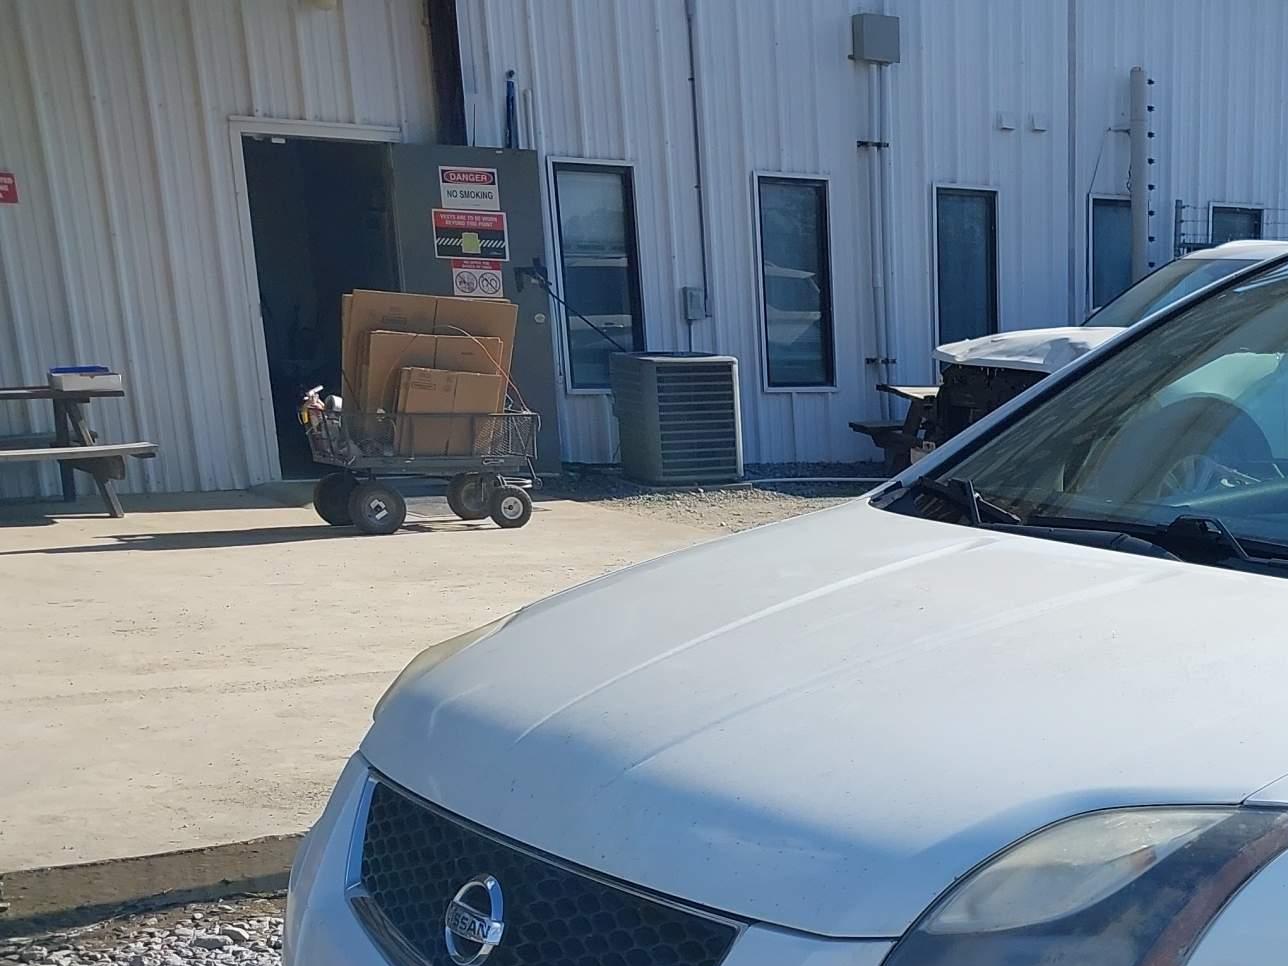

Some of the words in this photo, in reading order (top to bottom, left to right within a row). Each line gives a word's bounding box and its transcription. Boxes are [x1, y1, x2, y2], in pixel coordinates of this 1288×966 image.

[449, 173, 488, 182] DANGER
[446, 189, 458, 198] NO
[459, 190, 494, 200] SMOKING
